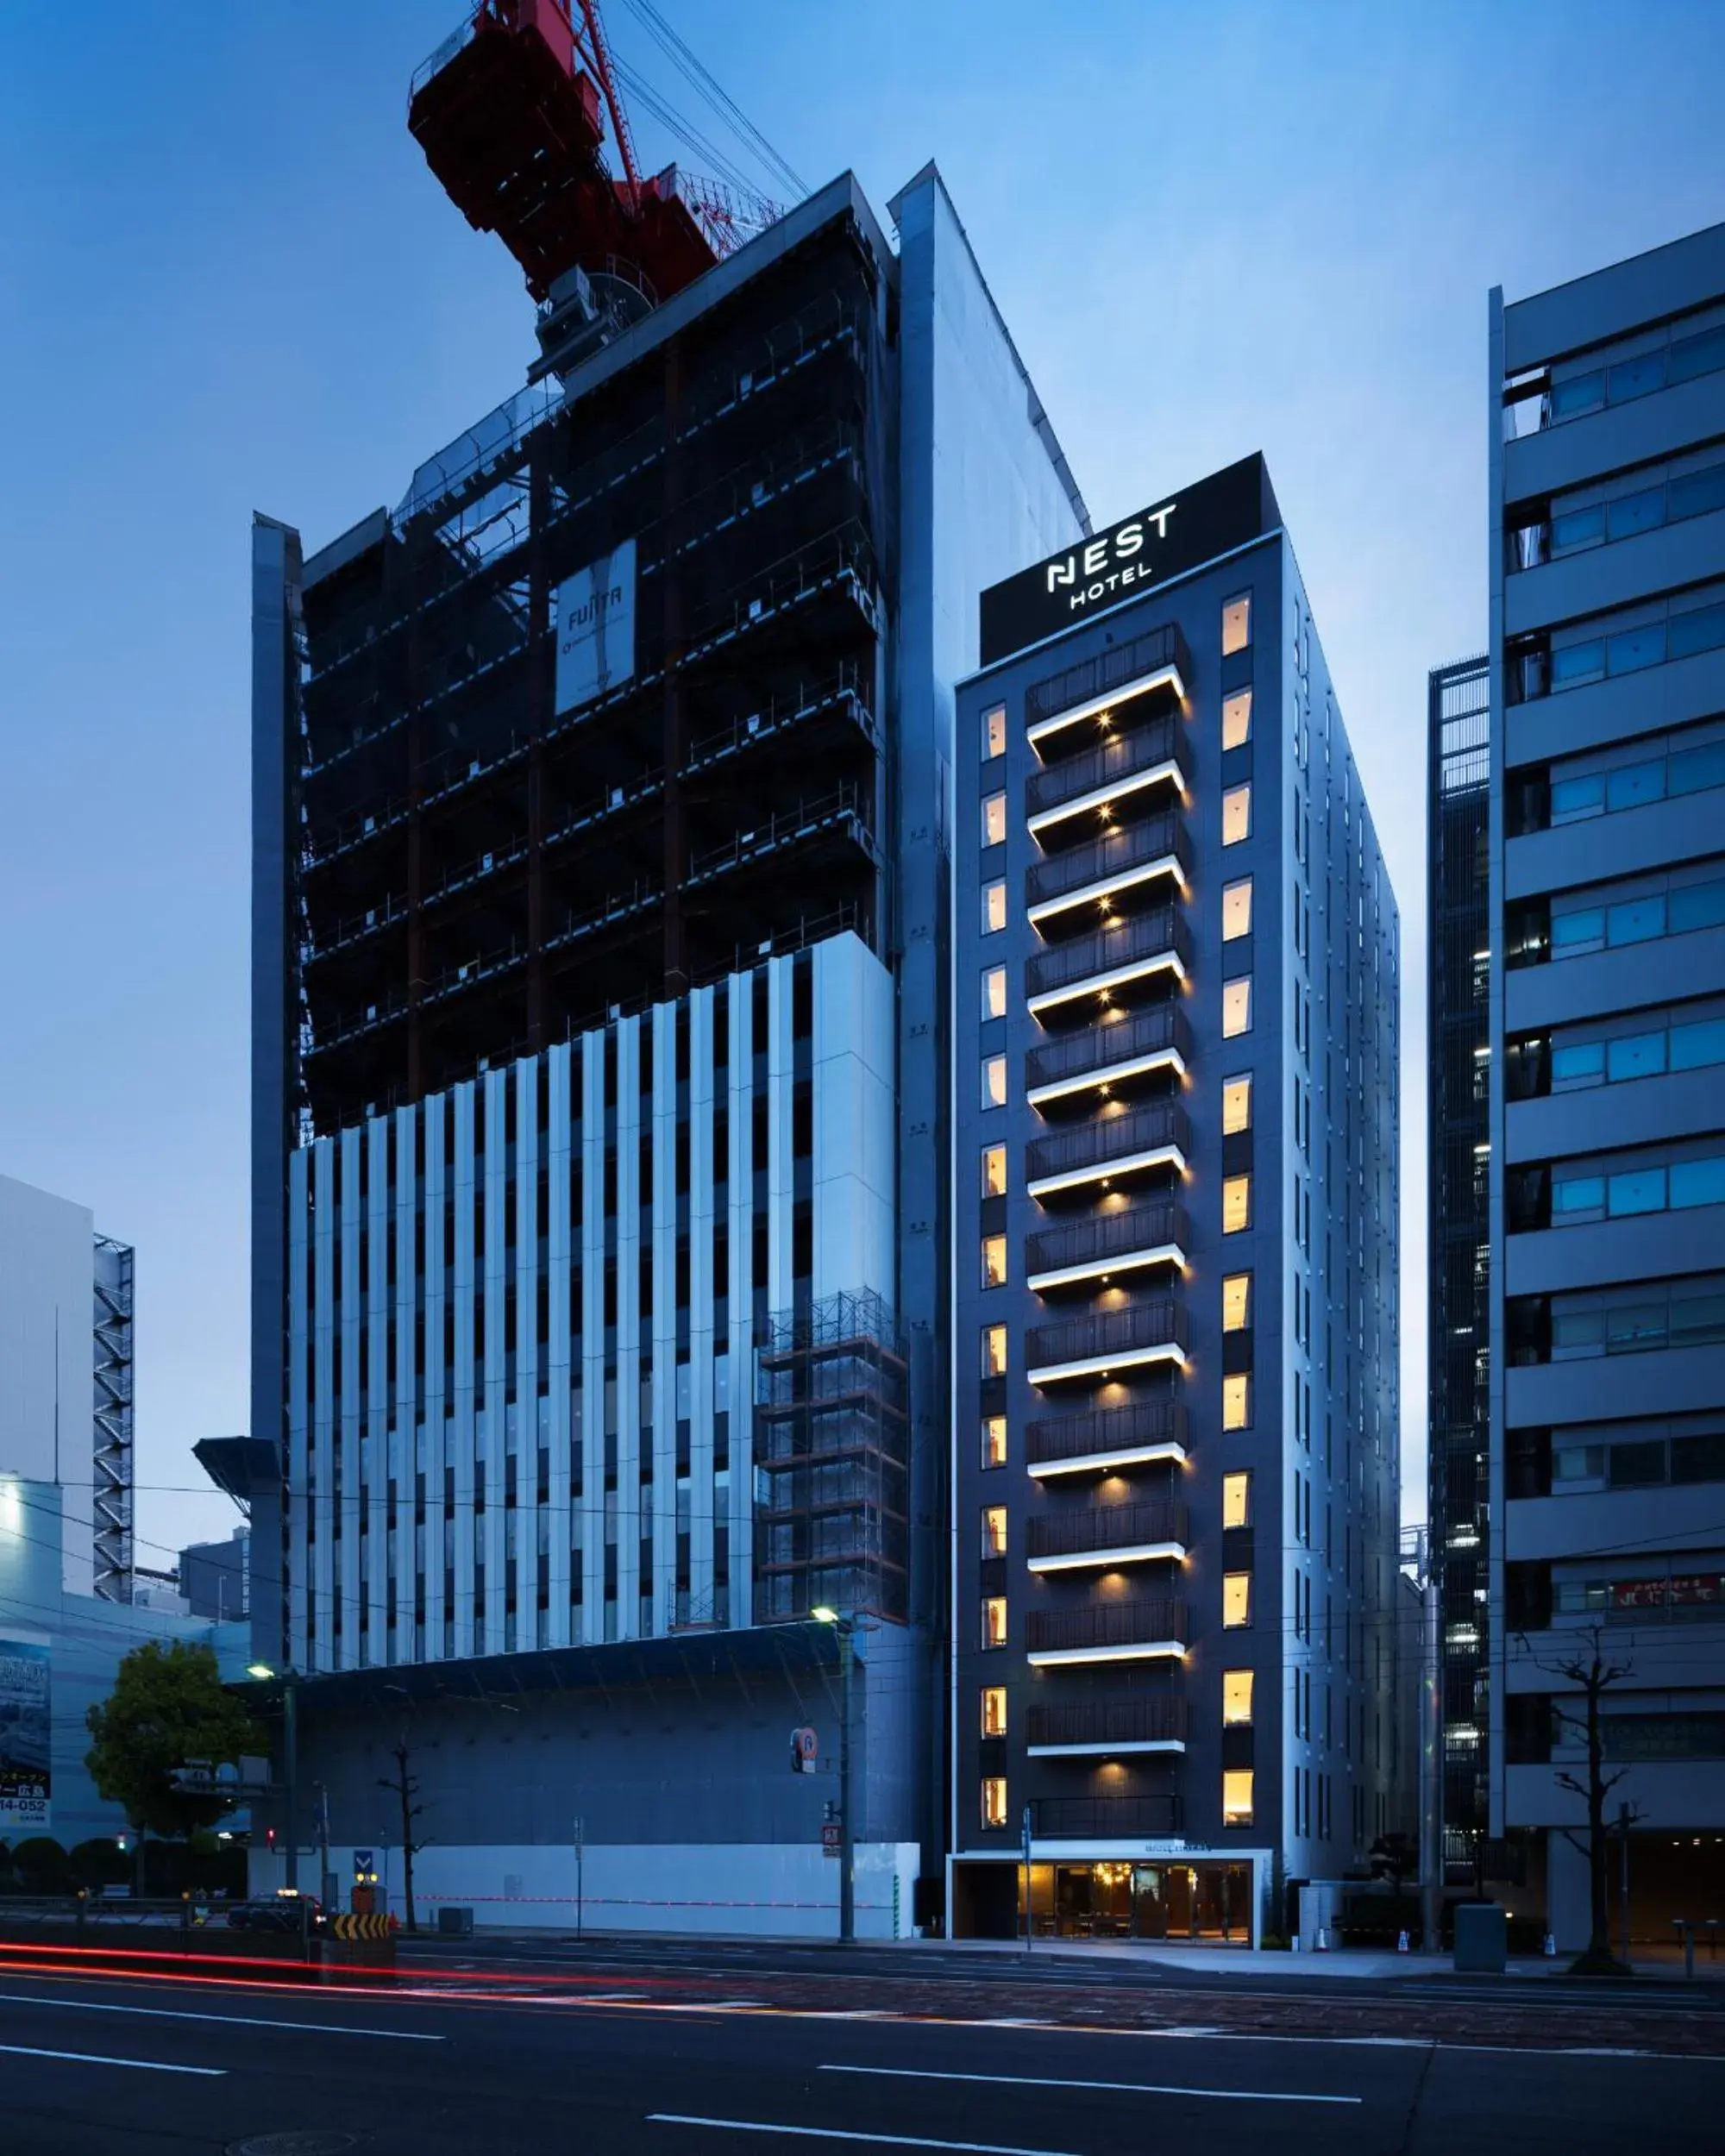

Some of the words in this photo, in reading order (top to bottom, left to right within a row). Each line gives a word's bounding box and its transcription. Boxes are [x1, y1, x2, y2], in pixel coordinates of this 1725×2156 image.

[1047, 504, 1176, 593] NEST
[1070, 562, 1152, 609] HOTEL
[0, 1784, 45, 1797] ー広島
